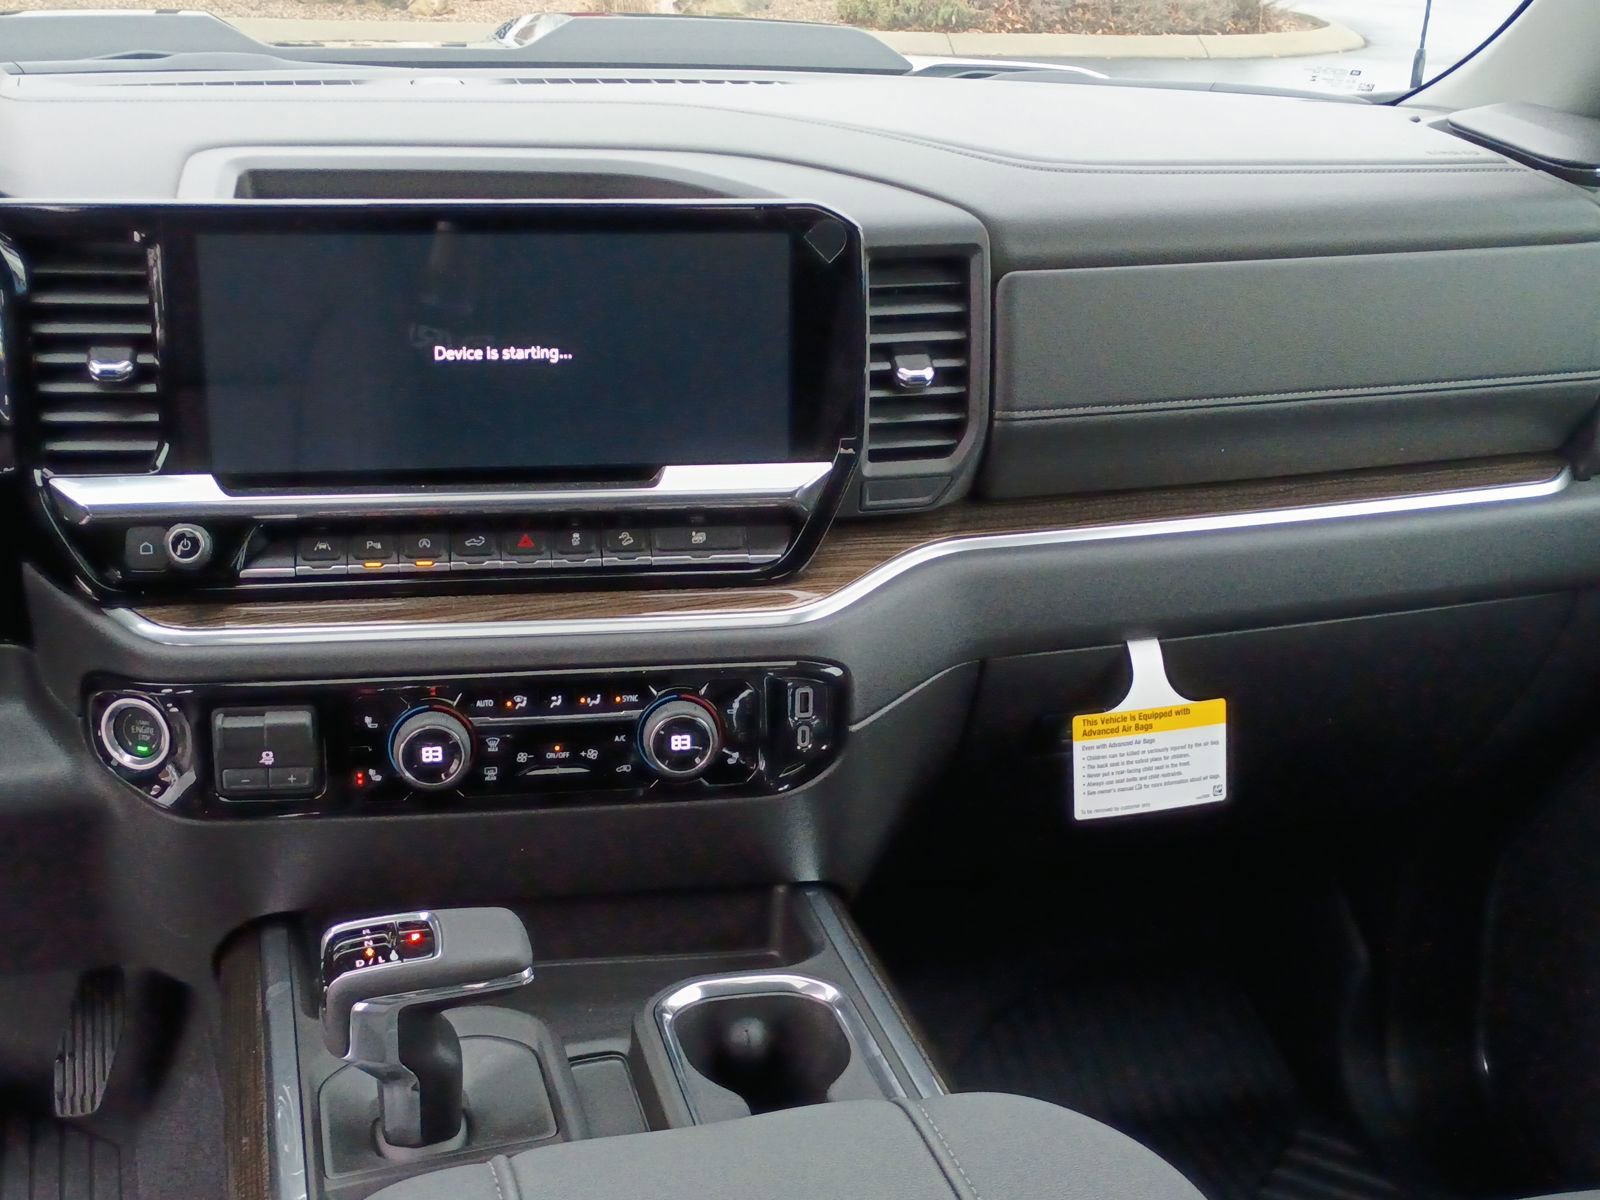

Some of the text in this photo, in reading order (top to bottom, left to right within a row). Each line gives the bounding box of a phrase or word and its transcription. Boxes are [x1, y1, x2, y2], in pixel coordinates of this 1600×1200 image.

[433, 345, 573, 364] Device is starting...
[622, 694, 639, 703] SYNC
[476, 699, 494, 708] AUTO
[1082, 718, 1098, 727] This
[1100, 715, 1128, 725] Vehicle
[1138, 709, 1173, 721] Equipped
[1174, 707, 1191, 717] with
[1082, 722, 1153, 737] Advanced Air Bags
[614, 734, 626, 743] A/C
[671, 734, 691, 751] 83
[421, 745, 443, 763] 83
[546, 752, 570, 760] ON/OFF
[411, 933, 420, 941] P
[364, 940, 373, 948] N
